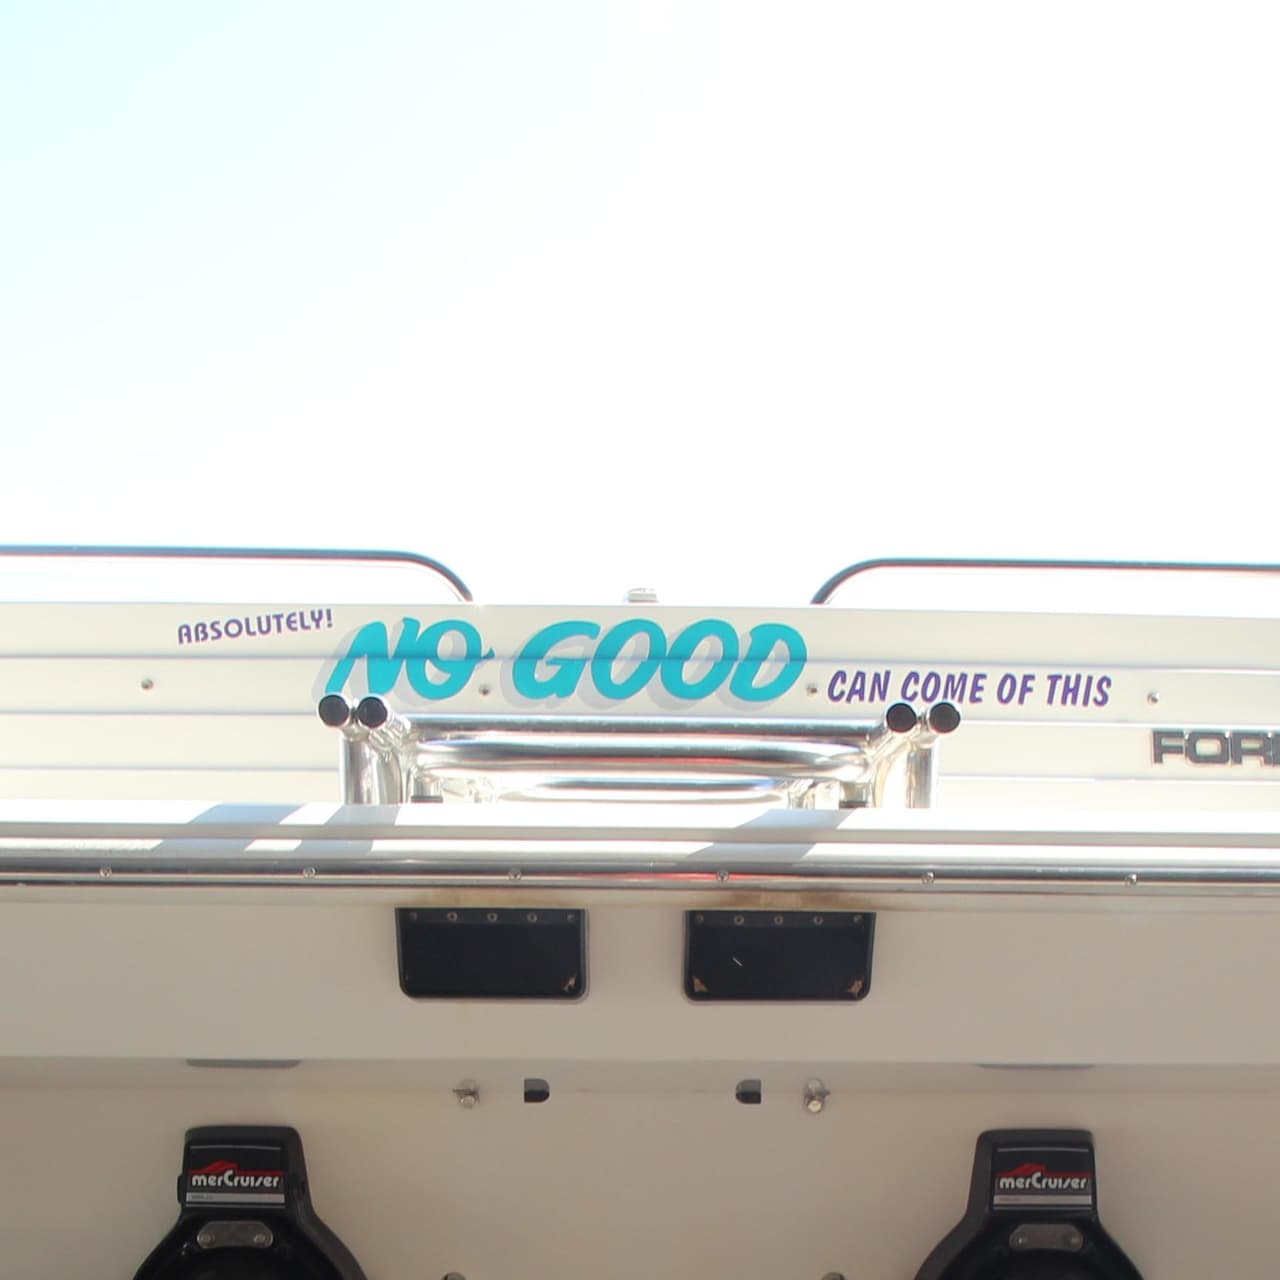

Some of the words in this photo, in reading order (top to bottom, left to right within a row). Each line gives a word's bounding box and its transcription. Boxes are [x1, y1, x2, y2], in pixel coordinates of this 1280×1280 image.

[177, 608, 333, 645] ABSOLUTELY!
[323, 617, 495, 701] NO
[513, 618, 807, 702] GOOD
[827, 670, 891, 704] CAN
[900, 671, 987, 704] COME
[996, 673, 1036, 705] OF
[1046, 673, 1112, 707] THIS
